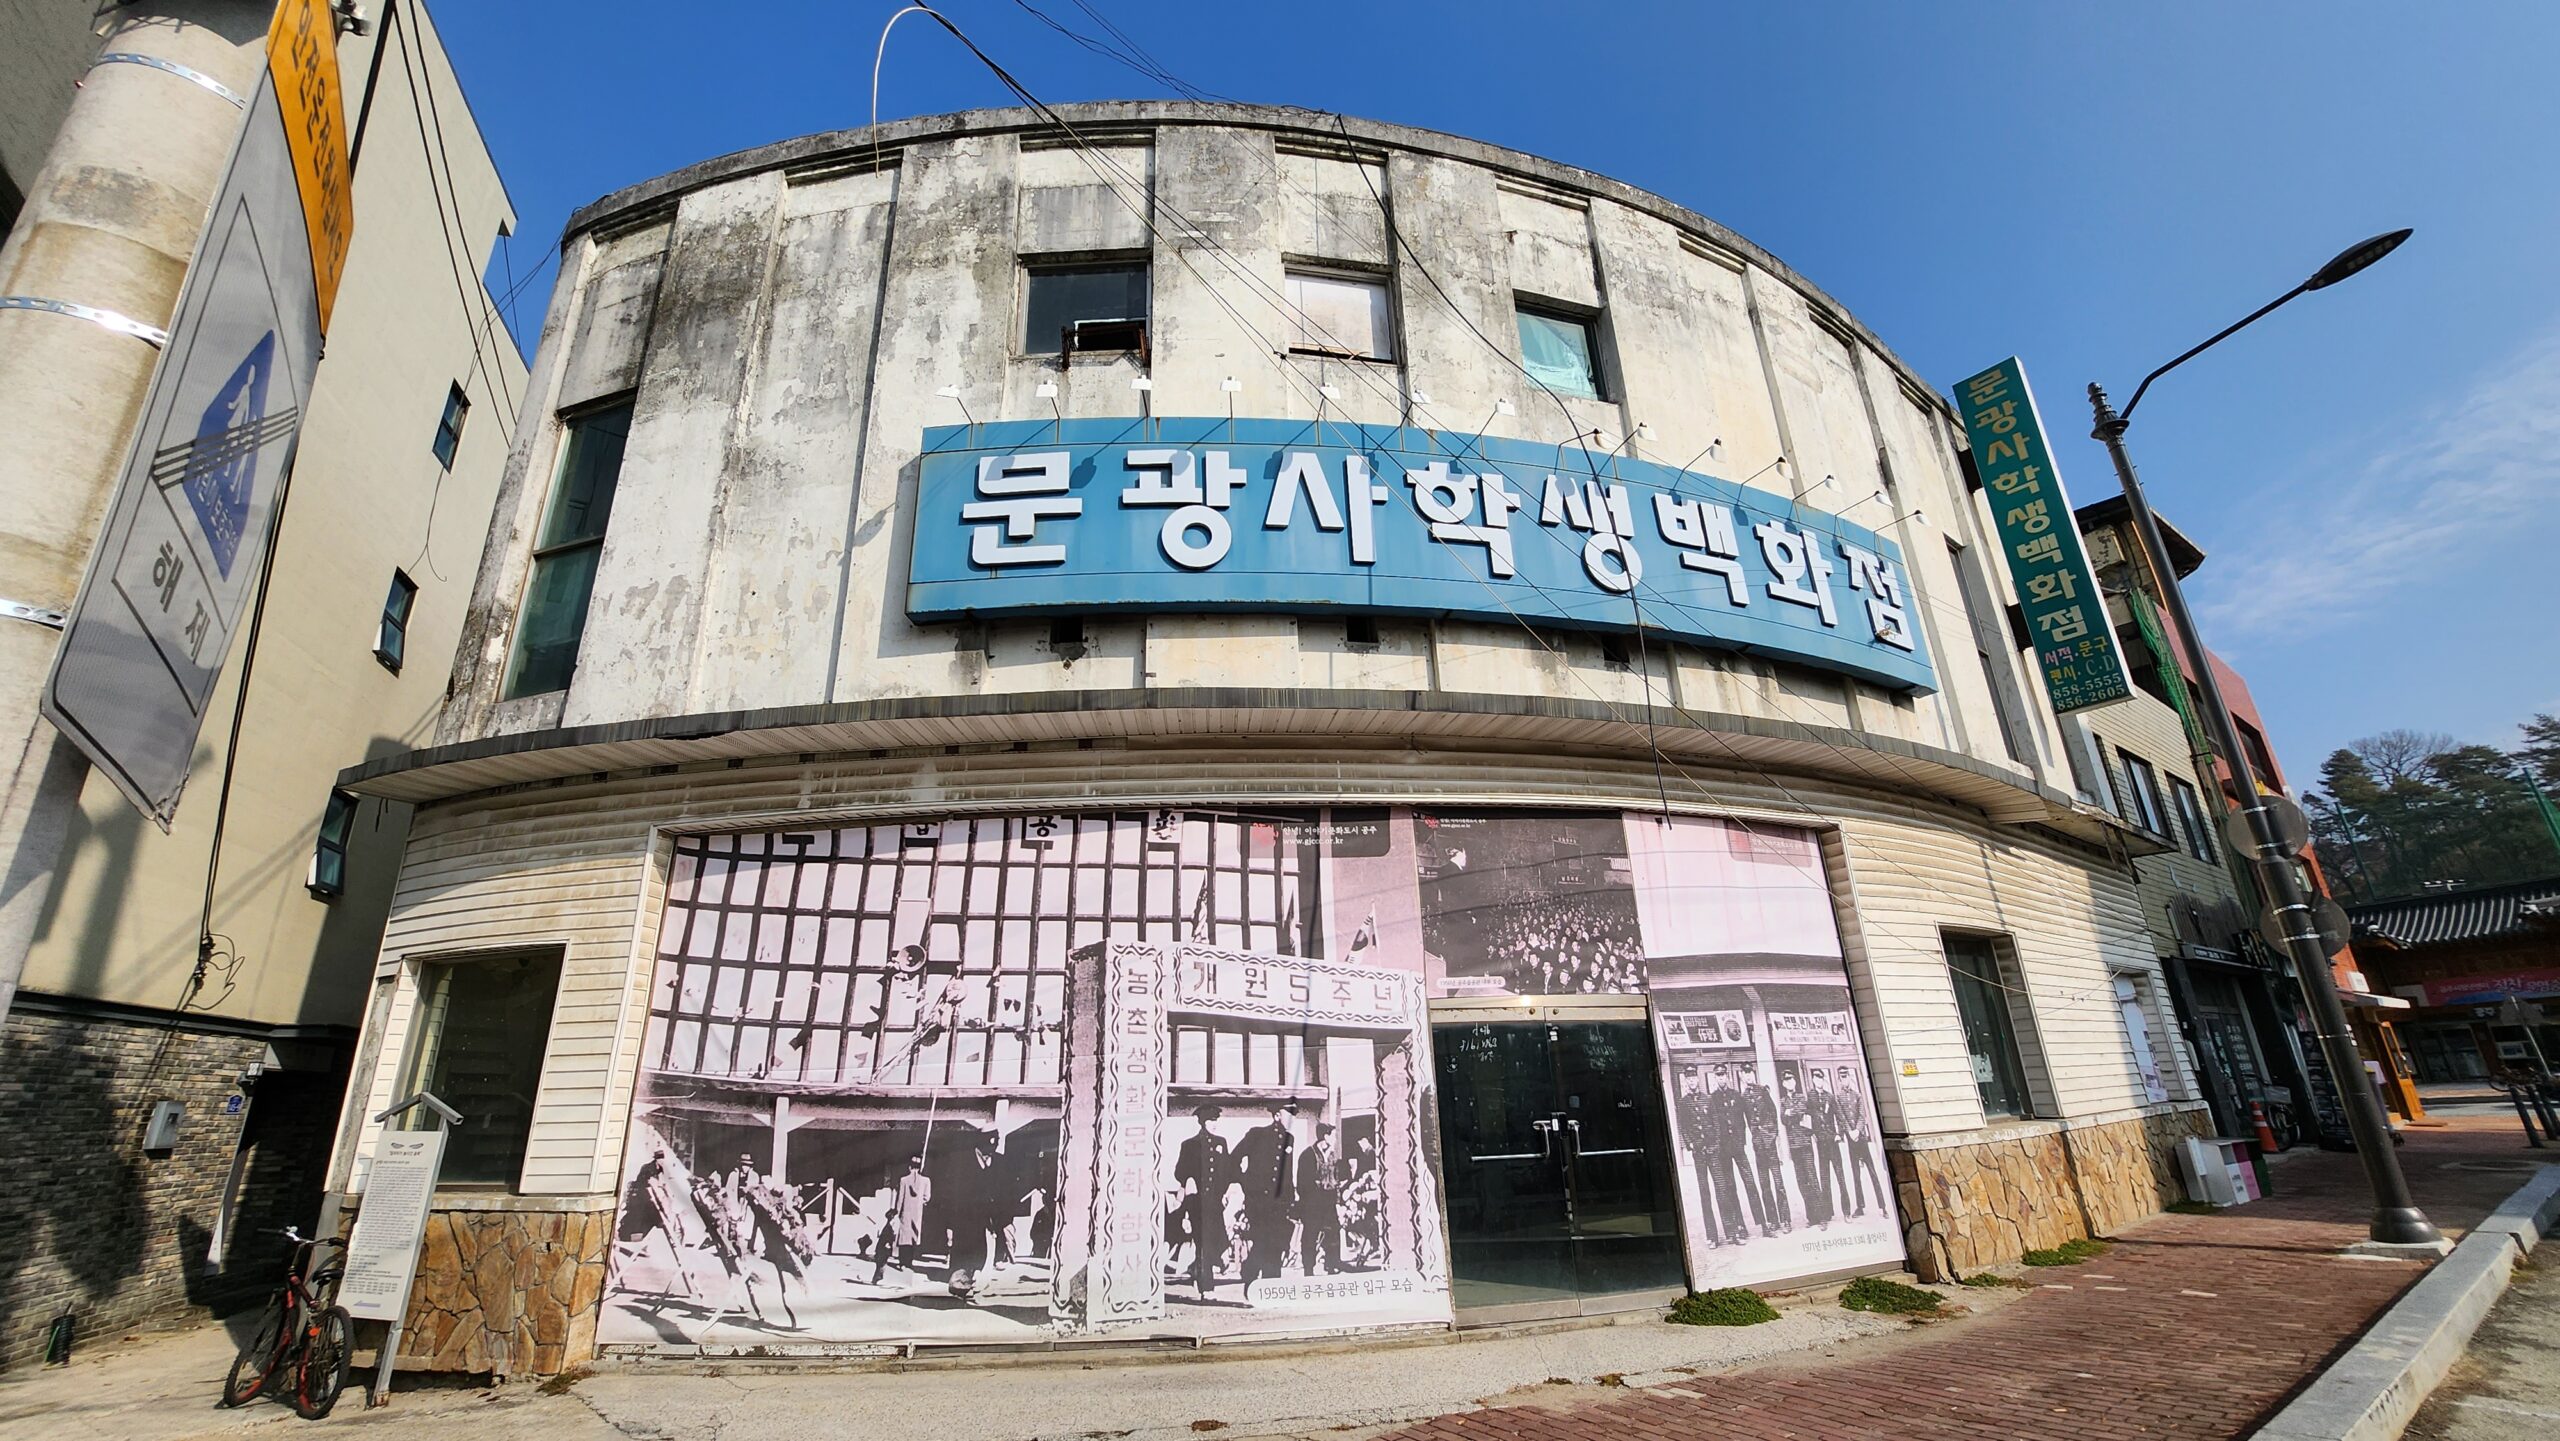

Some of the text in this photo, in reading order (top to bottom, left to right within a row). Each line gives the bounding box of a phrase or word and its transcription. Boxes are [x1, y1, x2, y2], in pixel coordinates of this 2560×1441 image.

[1968, 368, 2088, 642] 문광사학생백화점
[962, 450, 1914, 653] 문광사학생백화점
[2053, 673, 2121, 699] 858-5555
[2056, 684, 2125, 710] 856-2605
[1258, 1277, 1414, 1301] 1959년 공주읍공관 입구 모습
